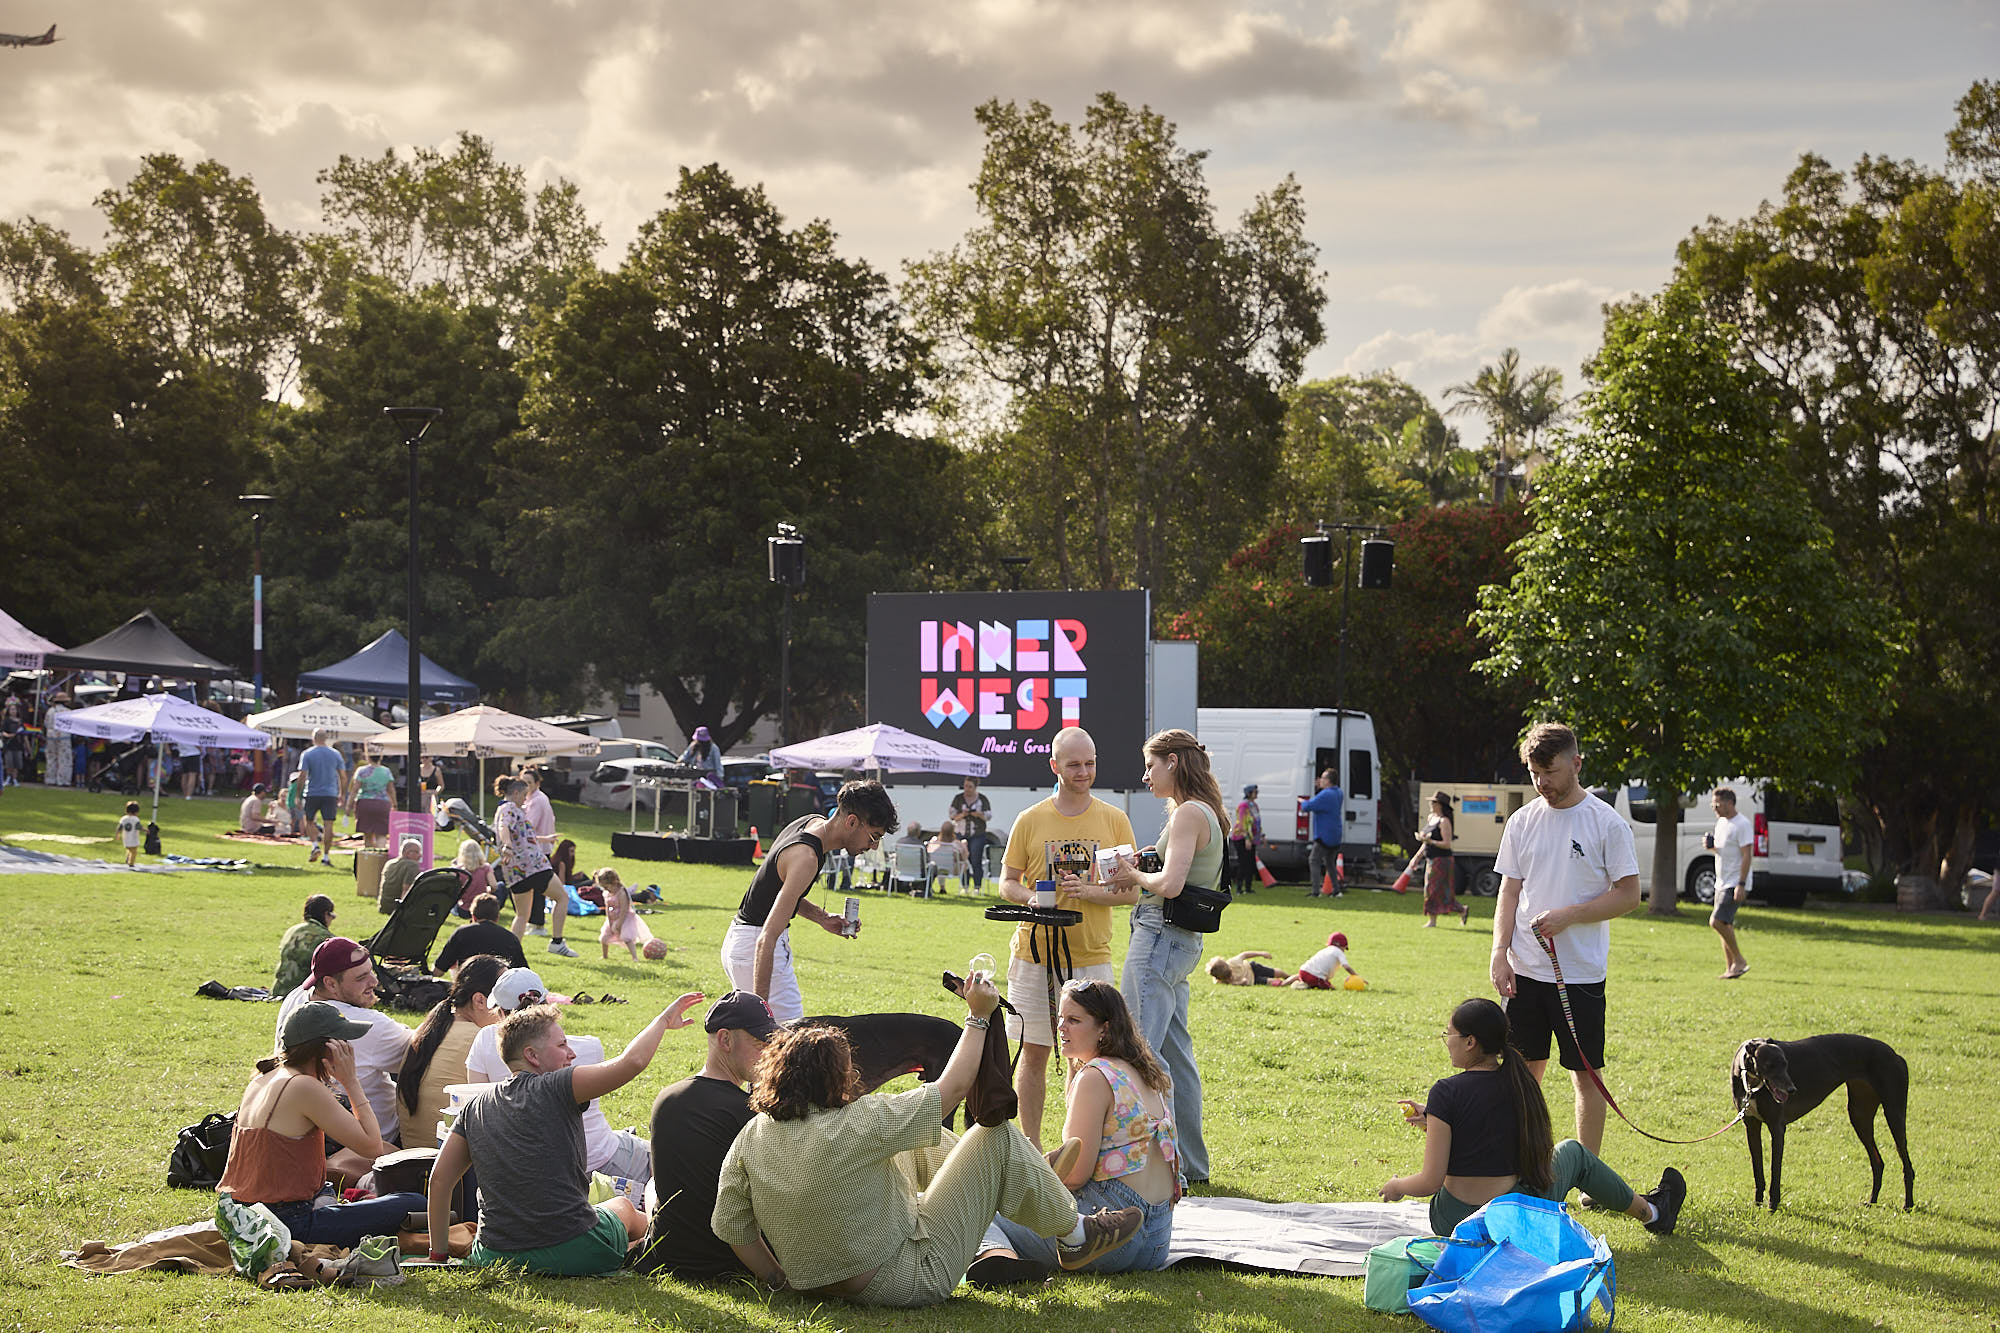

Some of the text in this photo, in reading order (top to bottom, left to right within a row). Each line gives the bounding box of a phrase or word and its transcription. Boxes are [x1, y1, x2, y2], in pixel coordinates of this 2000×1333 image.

[920, 619, 1088, 672] INNER
[920, 677, 1088, 730] WEST
[981, 736, 1051, 755] Mardi Gras
